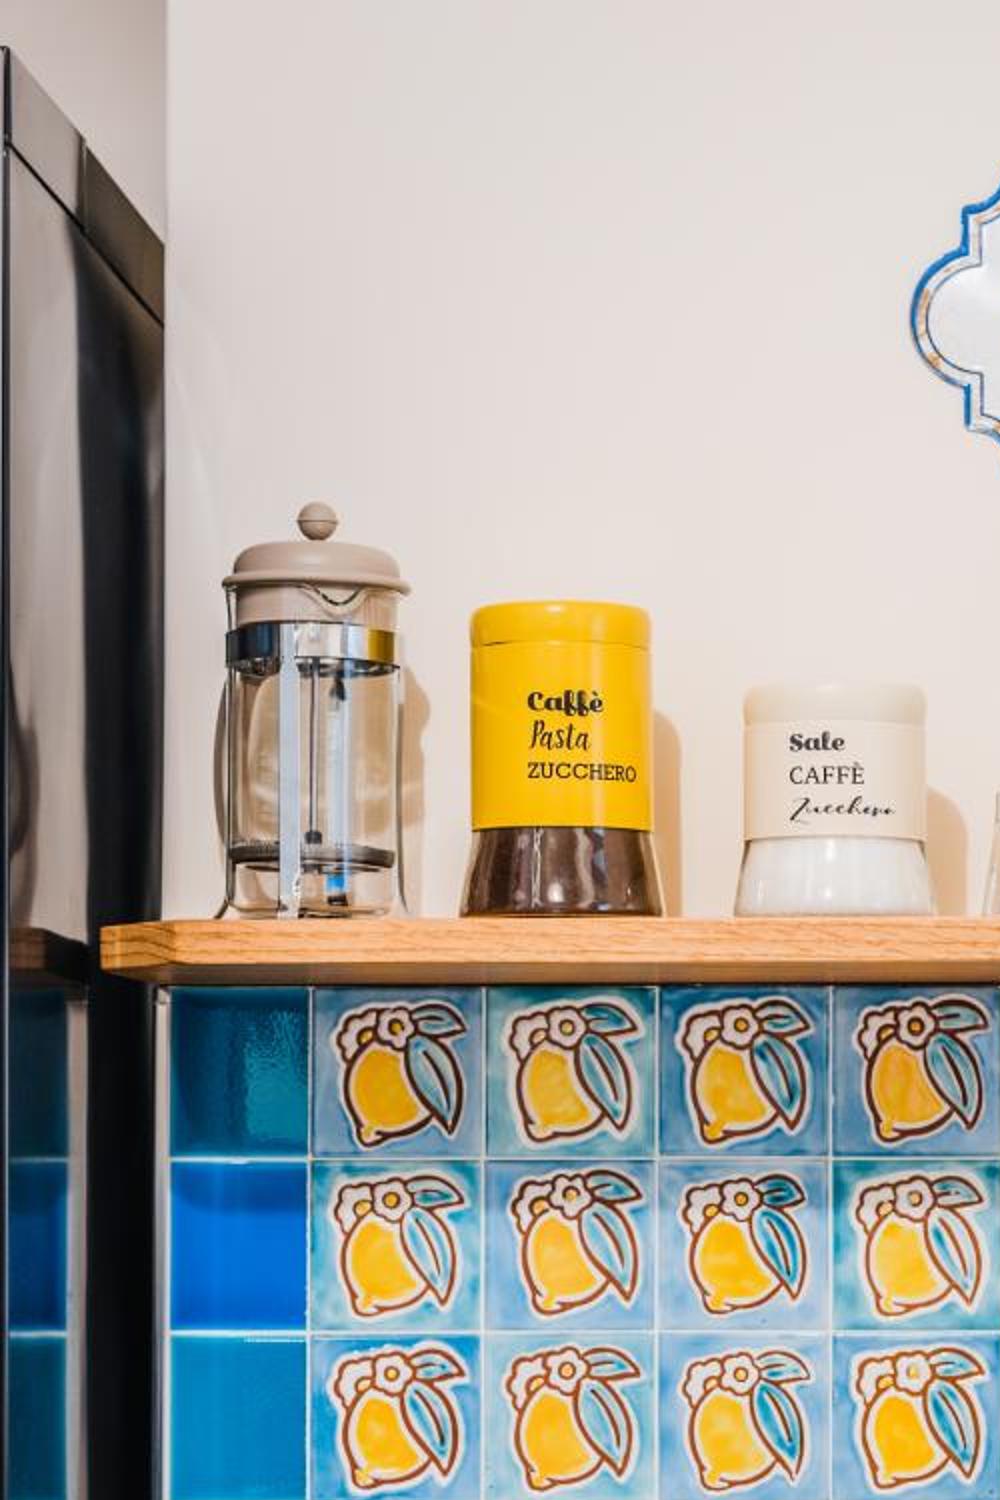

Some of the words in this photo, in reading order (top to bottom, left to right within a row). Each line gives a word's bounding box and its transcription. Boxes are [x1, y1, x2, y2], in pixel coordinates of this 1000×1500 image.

[527, 689, 604, 717] Caffè
[529, 719, 591, 752] Pasta
[789, 731, 846, 753] Sale
[527, 762, 637, 783] ZUCCHERO
[789, 761, 865, 785] CAFFÈ
